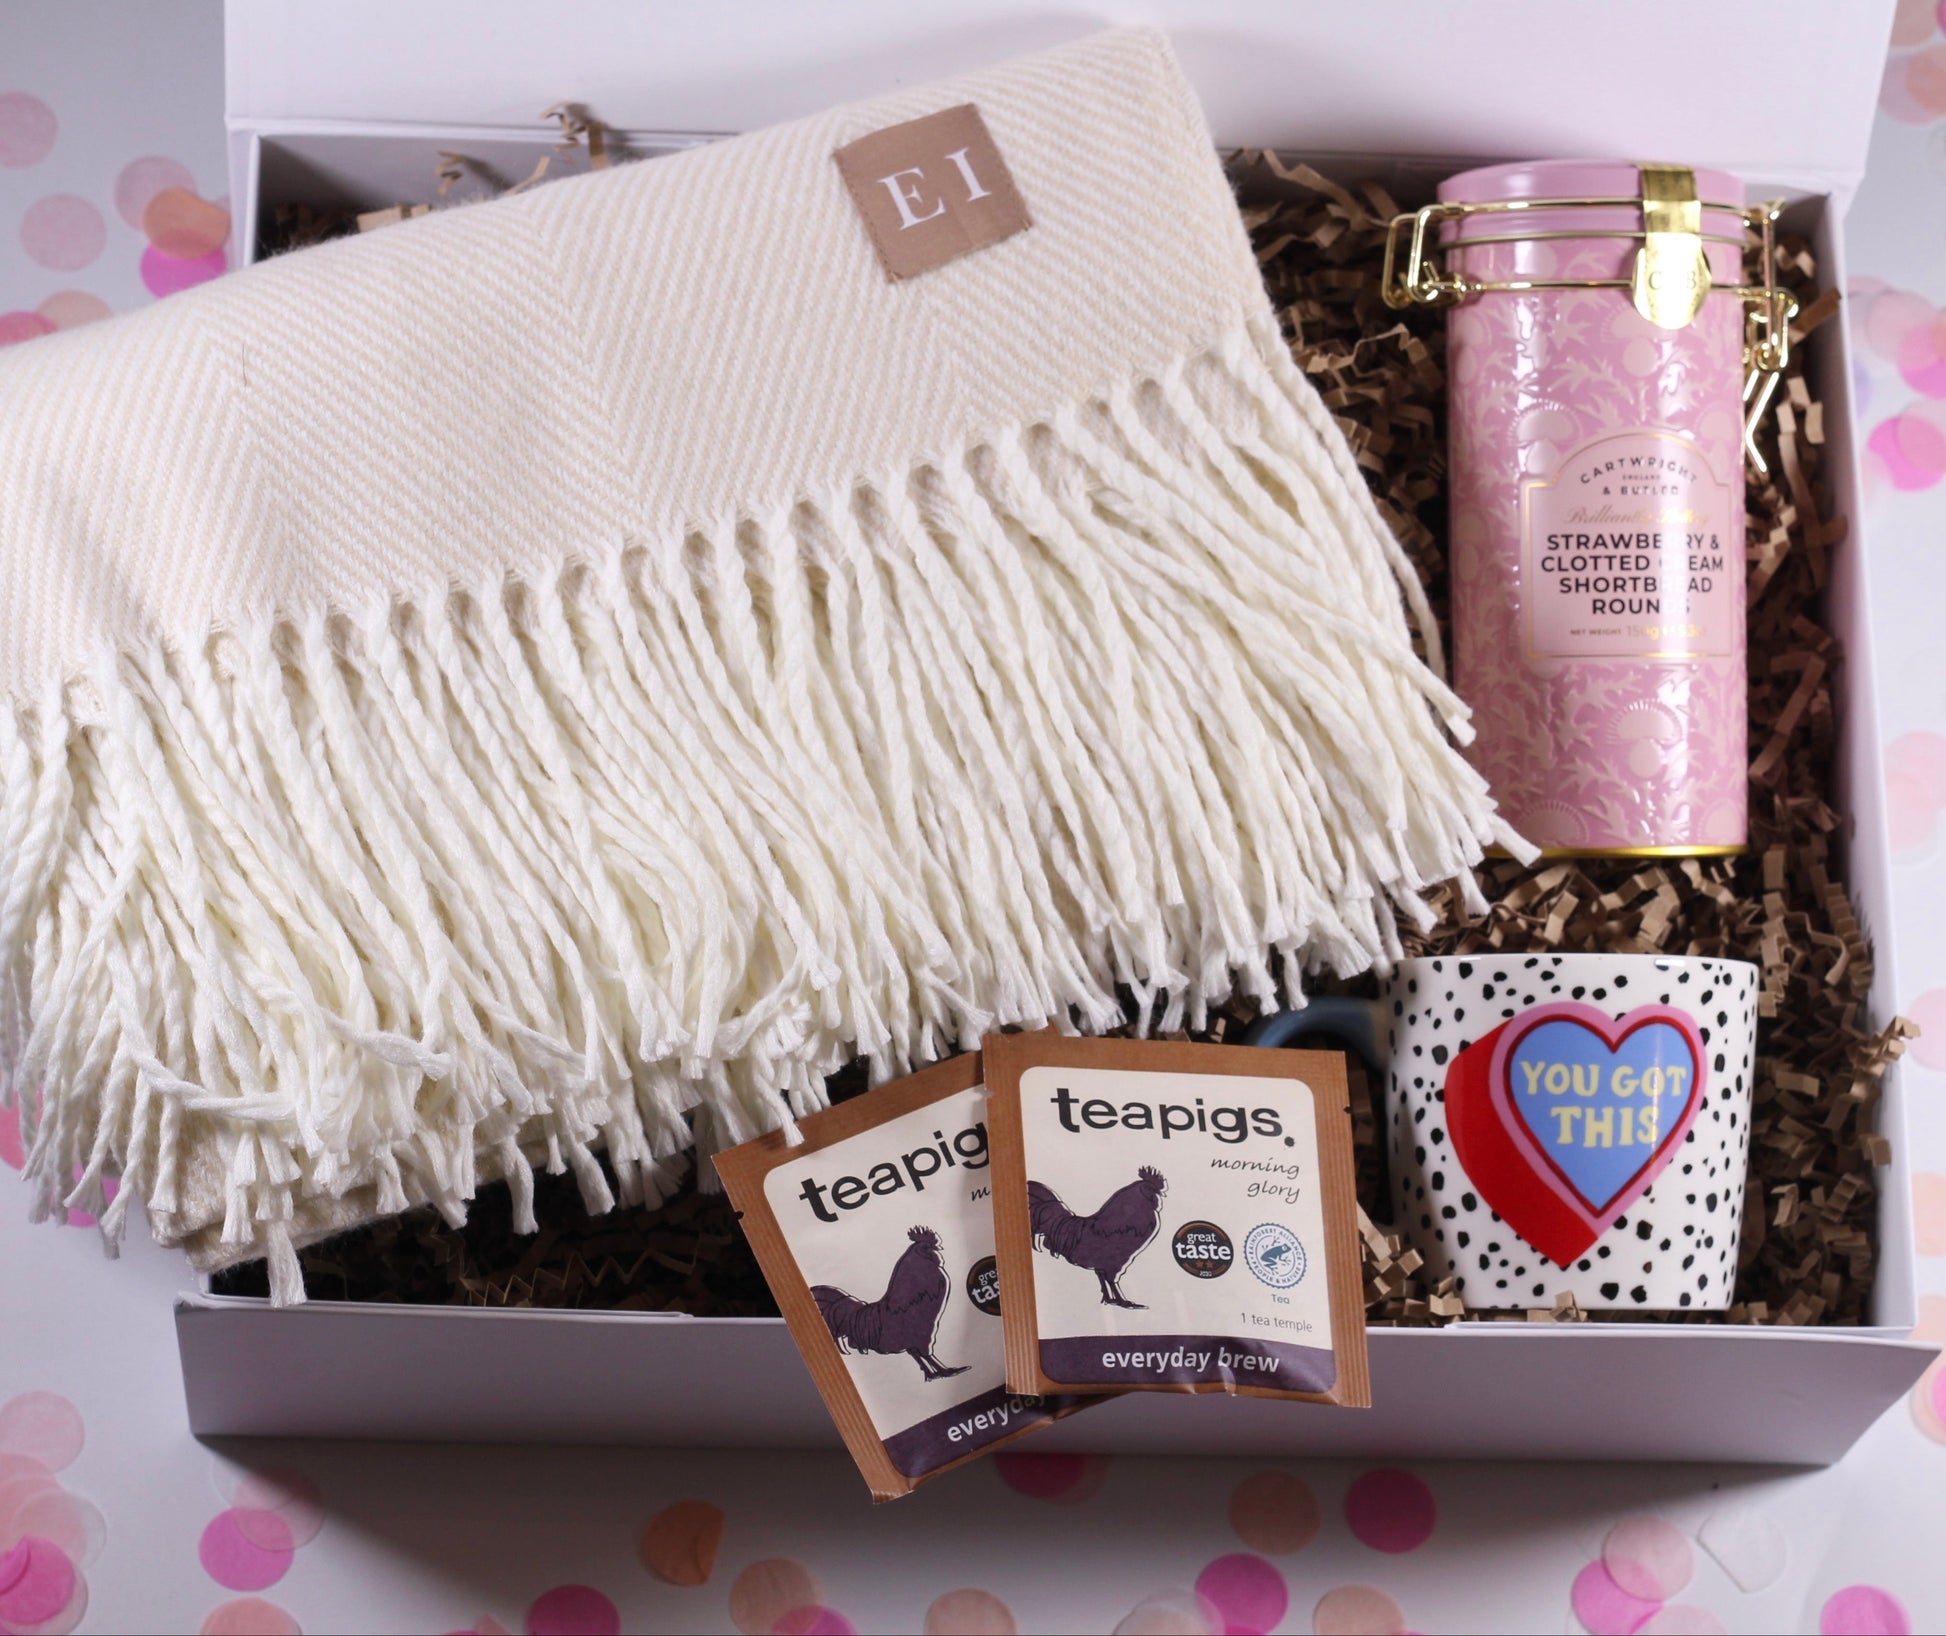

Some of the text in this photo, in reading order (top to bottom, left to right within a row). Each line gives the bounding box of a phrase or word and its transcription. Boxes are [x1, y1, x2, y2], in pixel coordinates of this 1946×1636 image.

[877, 147, 992, 230] E I
[1547, 533, 1720, 551] STRAWBERY &
[1541, 555, 1650, 572] CLOTTED
[1559, 577, 1712, 594] SHORTBAD
[1592, 598, 1690, 616] ROUN
[1519, 1060, 1686, 1097] YOU GOT
[1551, 1106, 1660, 1148] THIS
[799, 1122, 990, 1223] teapig
[1211, 1157, 1300, 1180] morning
[1247, 1180, 1300, 1204] glory
[1187, 1233, 1217, 1245] great
[1175, 1242, 1231, 1260] taste
[978, 1268, 998, 1286] gre
[1241, 1312, 1313, 1333] 1 tea temple
[1102, 1346, 1280, 1374] everyday brew
